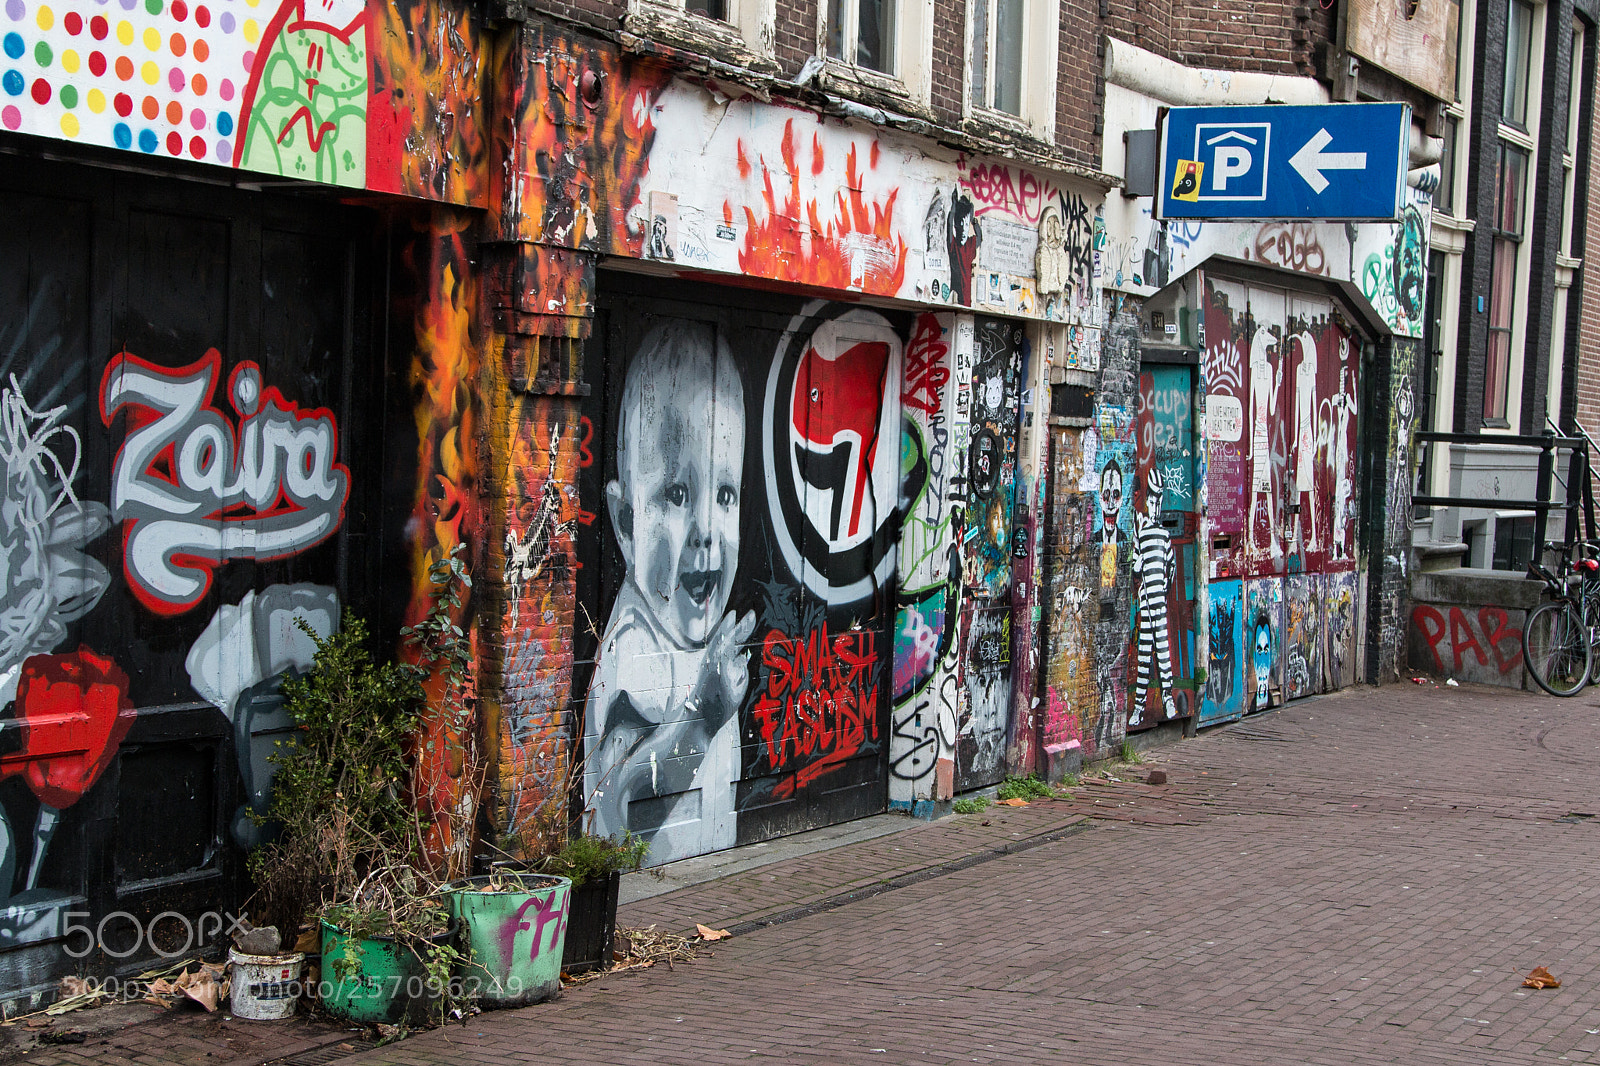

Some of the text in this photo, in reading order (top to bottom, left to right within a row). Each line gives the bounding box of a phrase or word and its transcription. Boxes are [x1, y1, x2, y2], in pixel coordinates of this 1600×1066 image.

[1212, 146, 1252, 190] P
[100, 347, 352, 565] Zaira
[762, 620, 878, 698] SMASH
[753, 685, 878, 768] FASCISM
